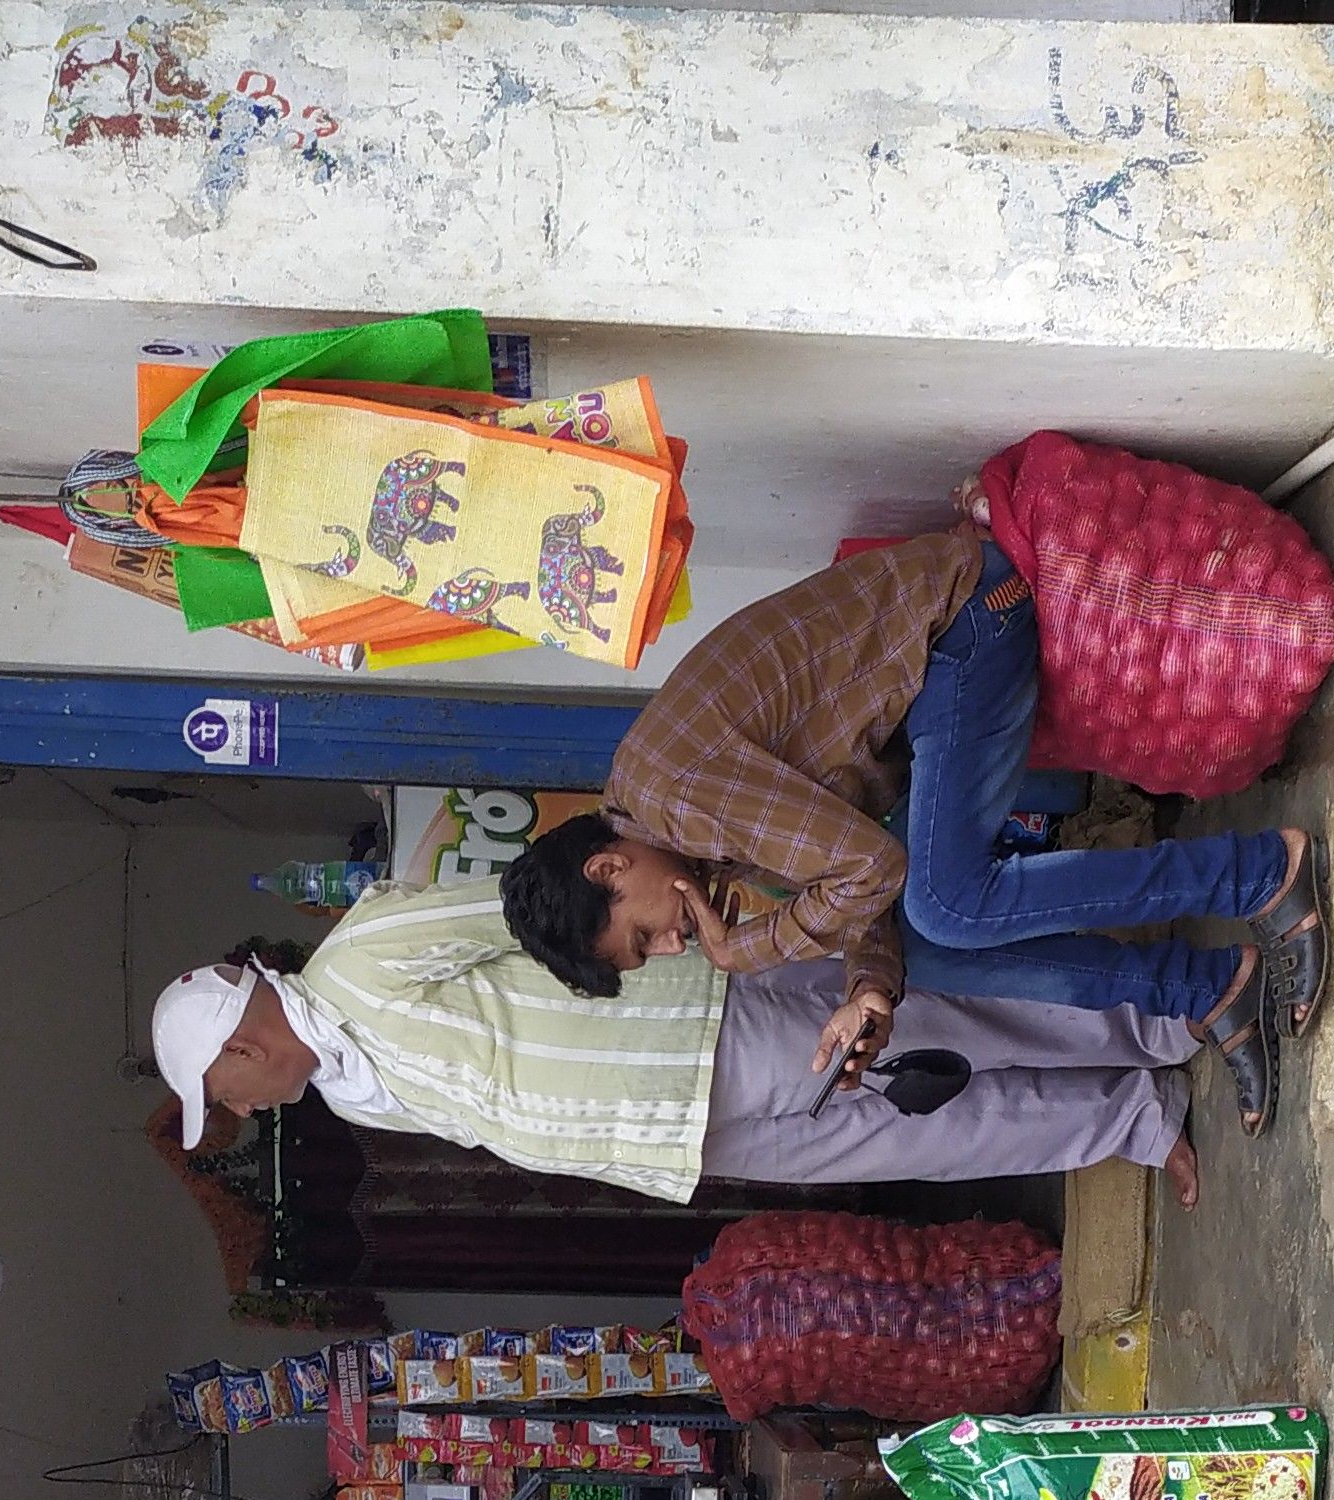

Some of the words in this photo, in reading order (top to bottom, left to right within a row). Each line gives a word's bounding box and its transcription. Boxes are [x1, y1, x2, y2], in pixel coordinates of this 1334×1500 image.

[578, 392, 614, 448] OU
[232, 709, 243, 756] PhonePe
[336, 1351, 349, 1378] ENERGY
[339, 1379, 354, 1425] ELECTRIFYING
[1066, 1415, 1211, 1431] KURNOOL
